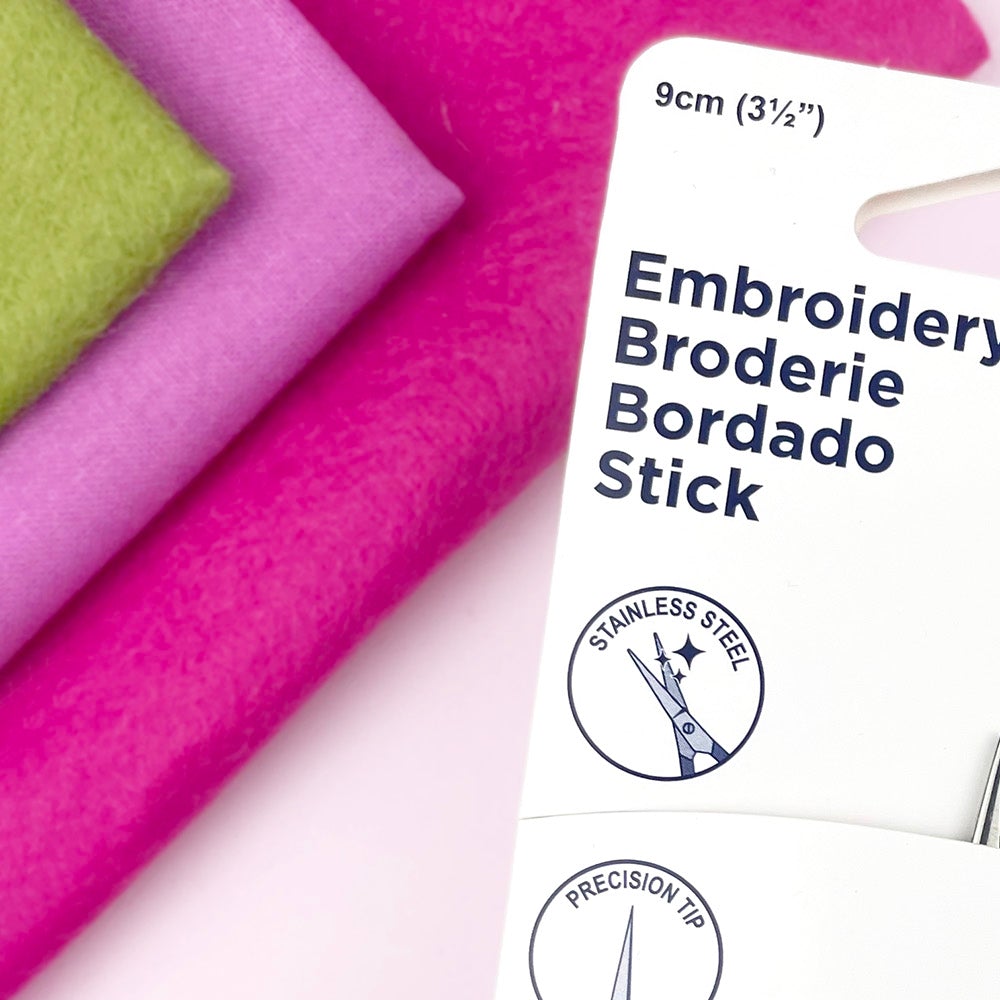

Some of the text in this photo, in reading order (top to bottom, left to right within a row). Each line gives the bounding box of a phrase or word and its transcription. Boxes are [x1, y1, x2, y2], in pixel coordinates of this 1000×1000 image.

[655, 82, 724, 115] 9cm
[615, 316, 904, 408] Broderie
[605, 382, 894, 474] Bordado
[594, 450, 763, 522] Stick
[589, 597, 750, 672] STAINLESS STEEL
[565, 870, 705, 928] PRECISION TIP
